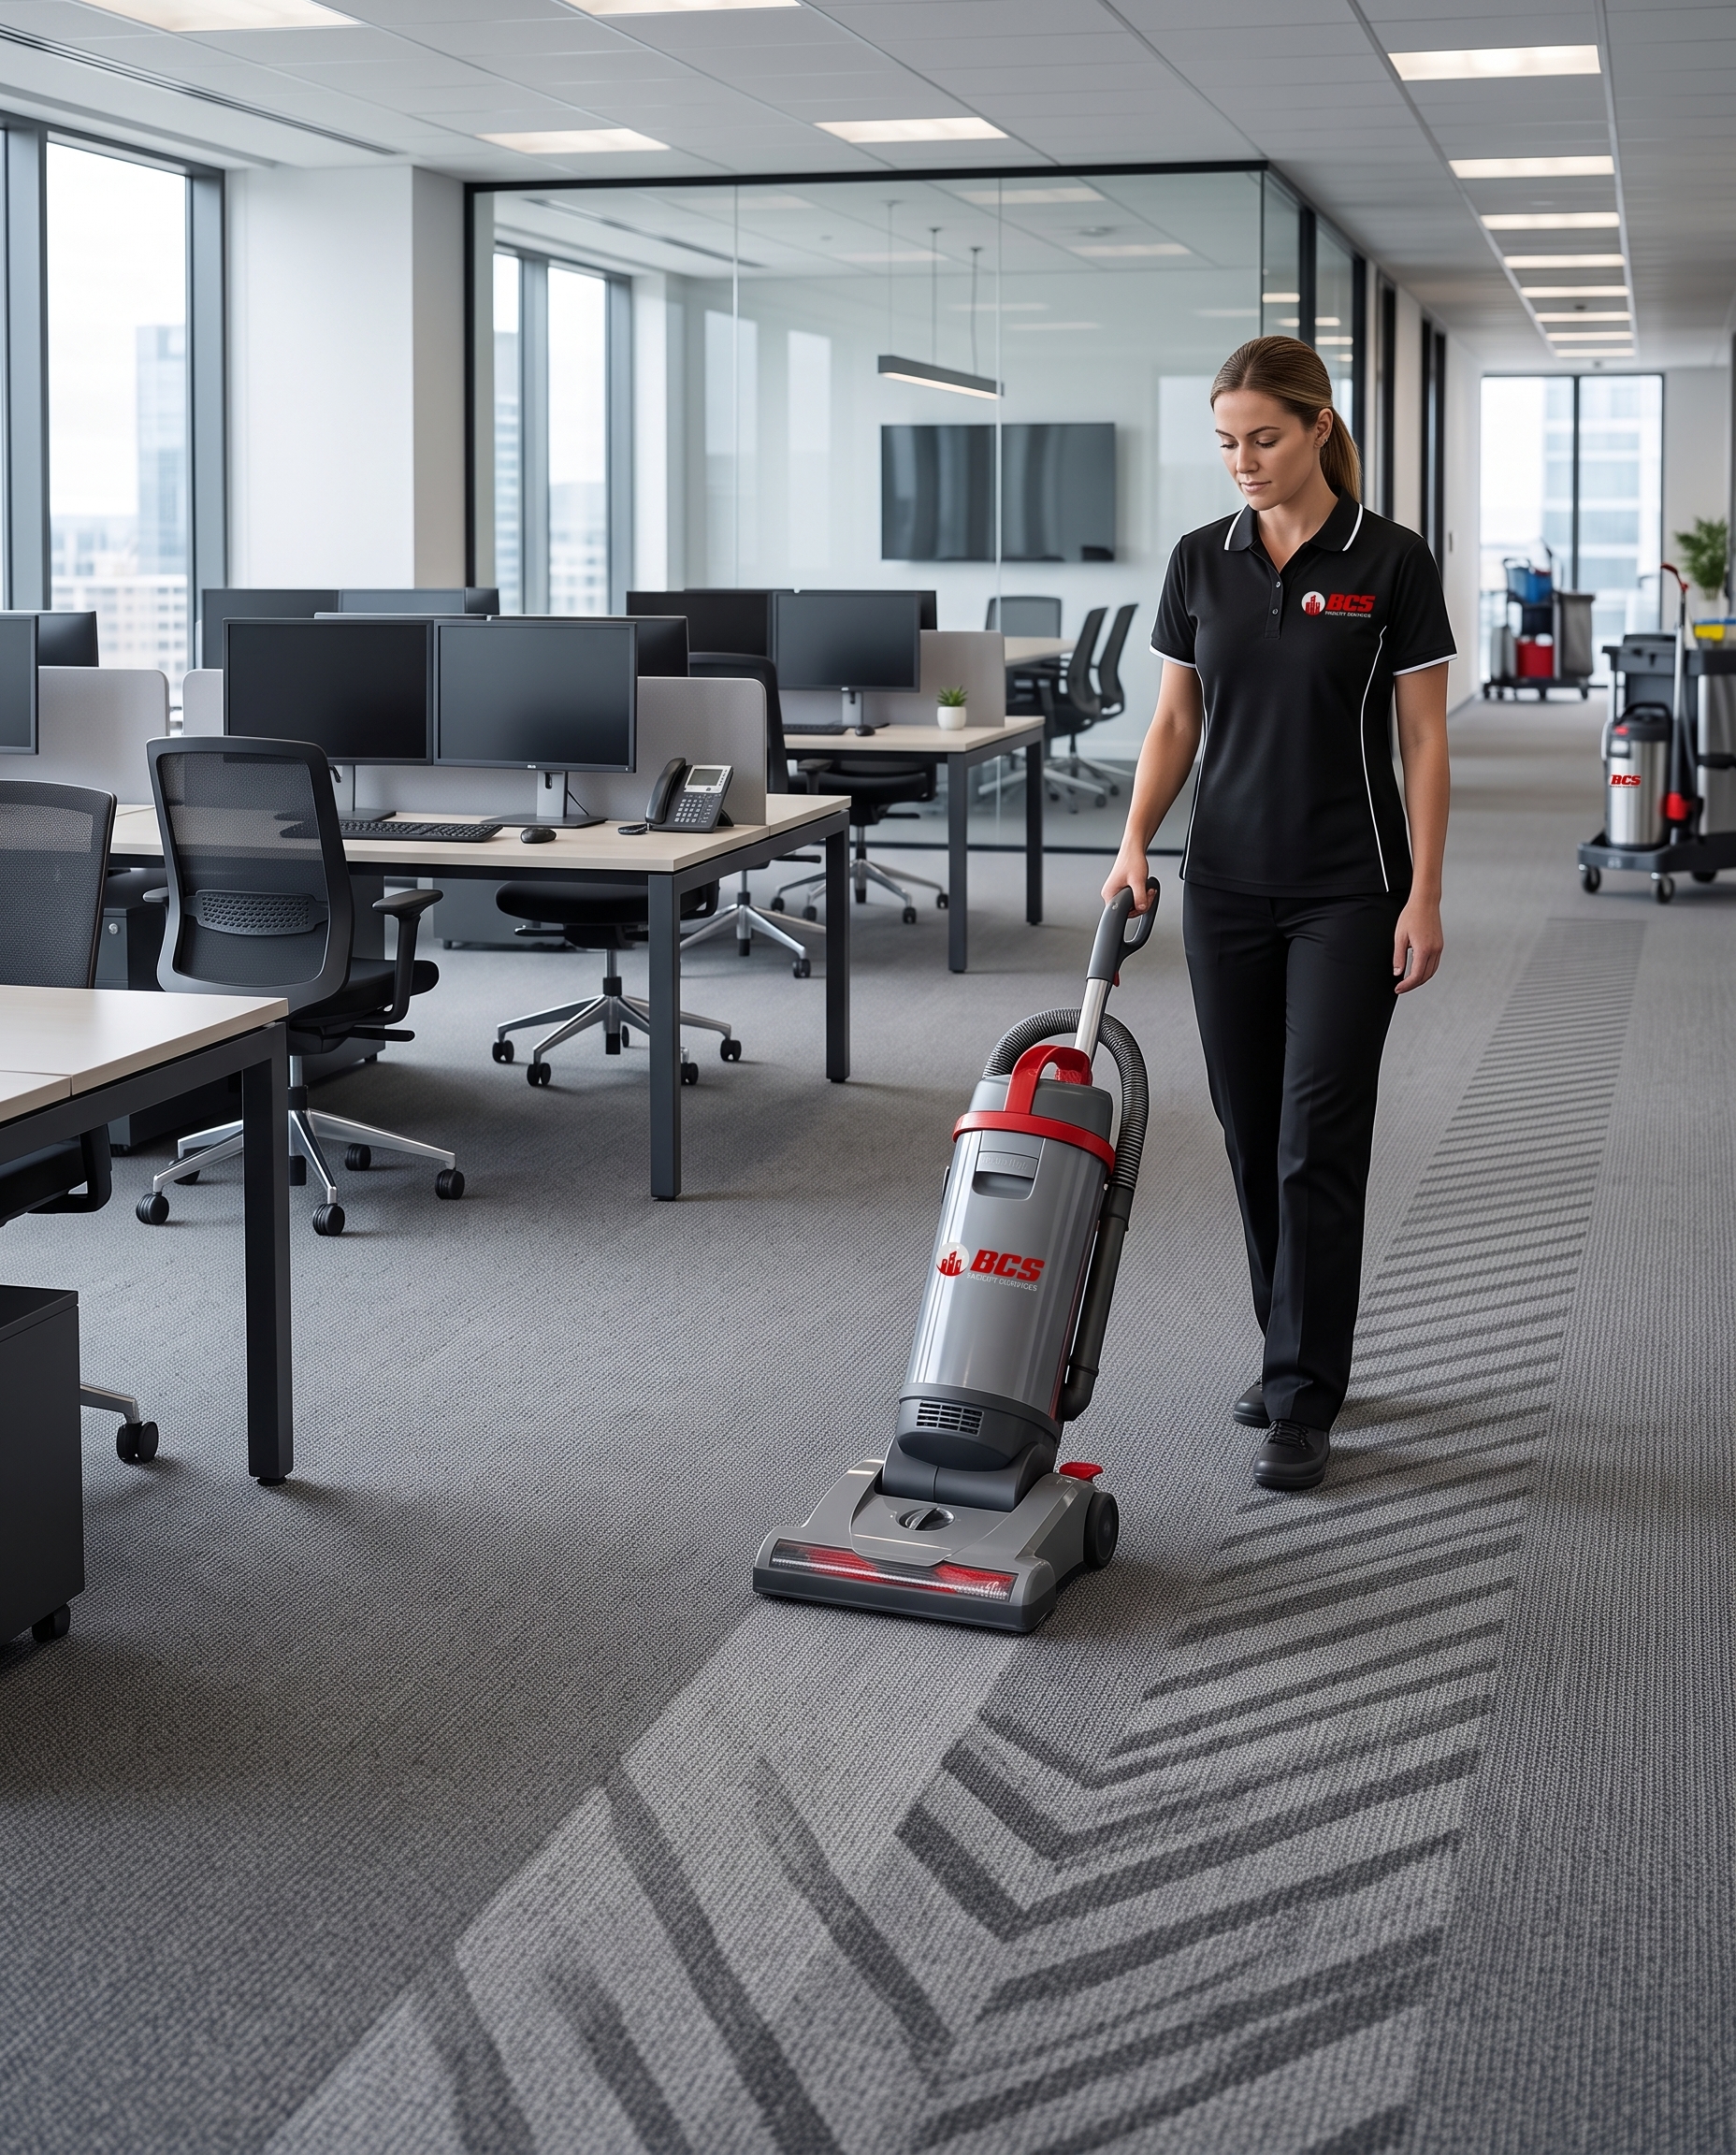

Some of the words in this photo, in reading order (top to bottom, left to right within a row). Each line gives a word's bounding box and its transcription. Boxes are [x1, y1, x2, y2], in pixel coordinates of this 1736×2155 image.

[1325, 593, 1376, 613] BCS
[1611, 774, 1642, 786] BCS
[970, 1249, 1046, 1282] BCS
